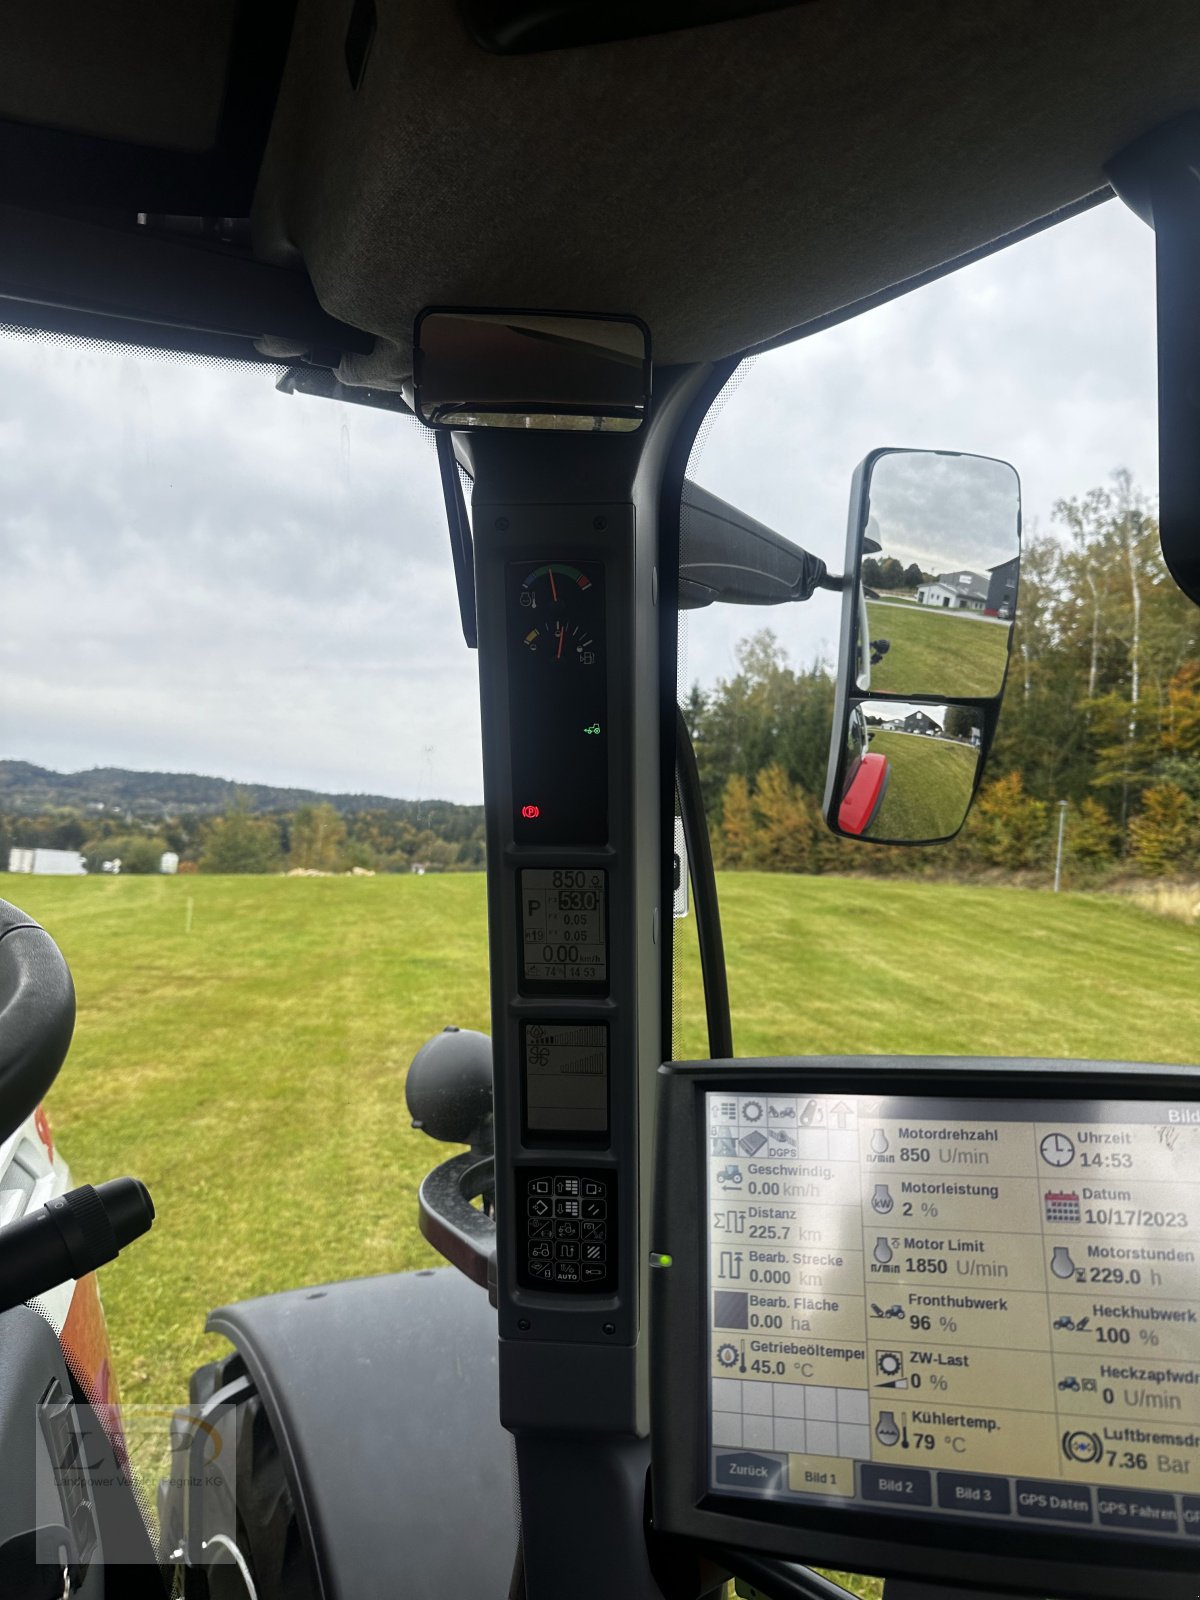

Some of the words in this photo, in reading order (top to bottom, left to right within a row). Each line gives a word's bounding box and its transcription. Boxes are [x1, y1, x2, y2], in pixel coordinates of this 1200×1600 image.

[552, 870, 586, 888] 850
[528, 900, 540, 916] P
[564, 914, 587, 925] 0.05
[564, 930, 588, 941] 0.05
[543, 945, 578, 962] 0.00
[898, 1128, 998, 1142] Motordrehzahl
[1078, 1132, 1132, 1144] Uhrzeit
[769, 1148, 796, 1158] DGPS
[900, 1148, 930, 1162] 850
[939, 1149, 989, 1164] U/min
[1080, 1152, 1132, 1168] 14:53
[748, 1164, 835, 1180] Geschwindig.
[748, 1182, 780, 1196] 0.00
[782, 1182, 820, 1198] km/h
[902, 1182, 999, 1200] Motorleistung
[1082, 1188, 1131, 1200] Datum
[748, 1206, 796, 1220] Distanz
[902, 1202, 913, 1216] 2
[920, 1202, 938, 1218] %
[1085, 1209, 1188, 1228] 10/17/2023
[749, 1226, 790, 1240] 225.7
[799, 1228, 822, 1242] km
[904, 1238, 944, 1250] Motor
[948, 1239, 984, 1252] Limit
[750, 1251, 789, 1264] Bearb.
[793, 1252, 843, 1266] Strecke
[1088, 1246, 1194, 1262] Motorstunden
[870, 1264, 900, 1274] n/min
[906, 1258, 948, 1274] 1850
[956, 1260, 1008, 1278] U/min
[750, 1269, 791, 1284] 0.000
[800, 1271, 823, 1286] km
[1090, 1268, 1141, 1284] 229.0
[1151, 1270, 1162, 1286] h
[750, 1296, 790, 1309] Bearb.
[794, 1297, 839, 1312] Fläche
[908, 1294, 1008, 1311] Fronthubwerk
[1092, 1304, 1198, 1322] Heckhubwerk
[750, 1314, 782, 1328] 0.00
[792, 1316, 811, 1332] ha
[910, 1316, 931, 1330] 96
[940, 1316, 957, 1333] %
[1096, 1327, 1130, 1344] 100
[1139, 1329, 1160, 1346] %
[910, 1352, 969, 1367] ZW-Last
[750, 1360, 786, 1375] 45.0
[794, 1363, 814, 1378] °C
[911, 1374, 921, 1388] 0
[930, 1374, 948, 1391] %
[1103, 1388, 1114, 1404] 0
[1124, 1389, 1182, 1410] U/min
[912, 1410, 1001, 1432] Kühlertemp.
[914, 1434, 936, 1450] 79
[944, 1436, 966, 1454] °C
[1106, 1450, 1148, 1470] 7.36
[1157, 1455, 1190, 1474] Bar
[730, 1463, 768, 1478] Zurück
[804, 1471, 828, 1484] Bild
[830, 1474, 836, 1484] 1
[878, 1478, 902, 1492] Bild
[904, 1482, 913, 1493] 2
[956, 1486, 980, 1500] Bild
[983, 1490, 992, 1501] 3
[1020, 1494, 1047, 1507] GPS
[1050, 1498, 1088, 1512] Daten
[1100, 1501, 1127, 1516] GPS
